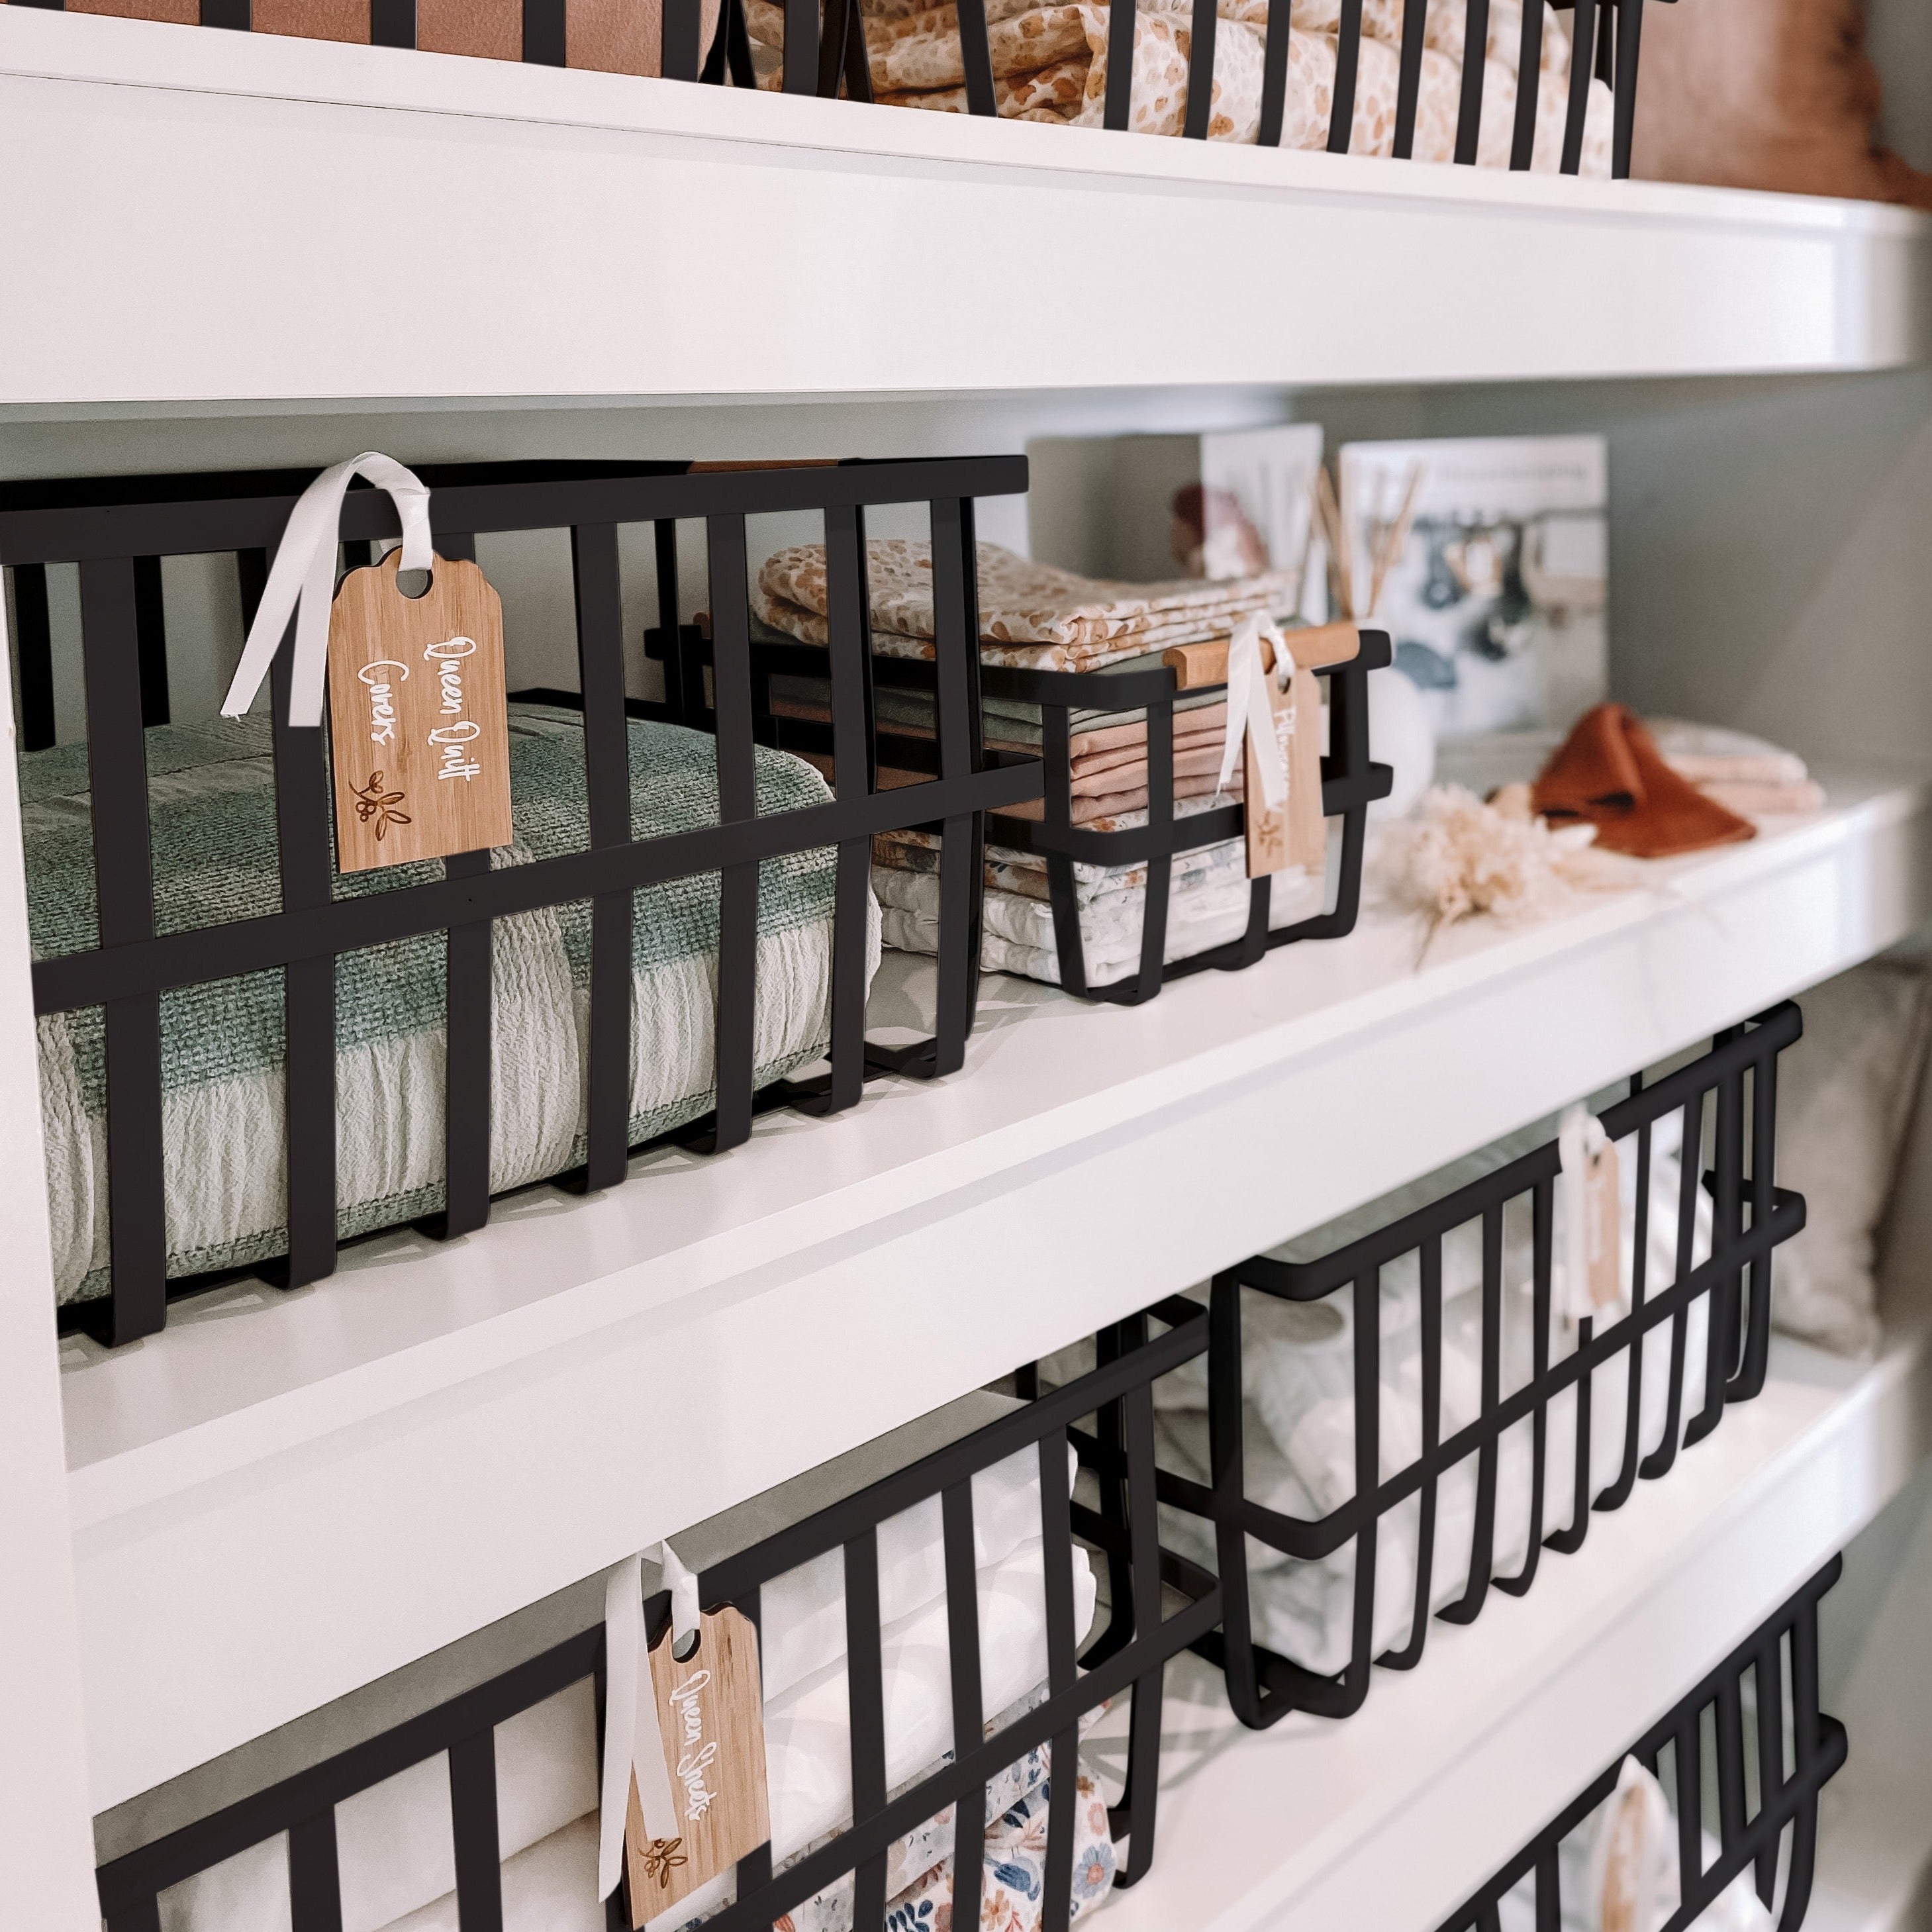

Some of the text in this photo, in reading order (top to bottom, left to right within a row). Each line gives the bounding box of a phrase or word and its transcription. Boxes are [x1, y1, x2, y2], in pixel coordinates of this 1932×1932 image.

[358, 660, 409, 746] Covers
[423, 636, 480, 782] Queen Quilt
[669, 1669, 717, 1821] Queen Sheets
